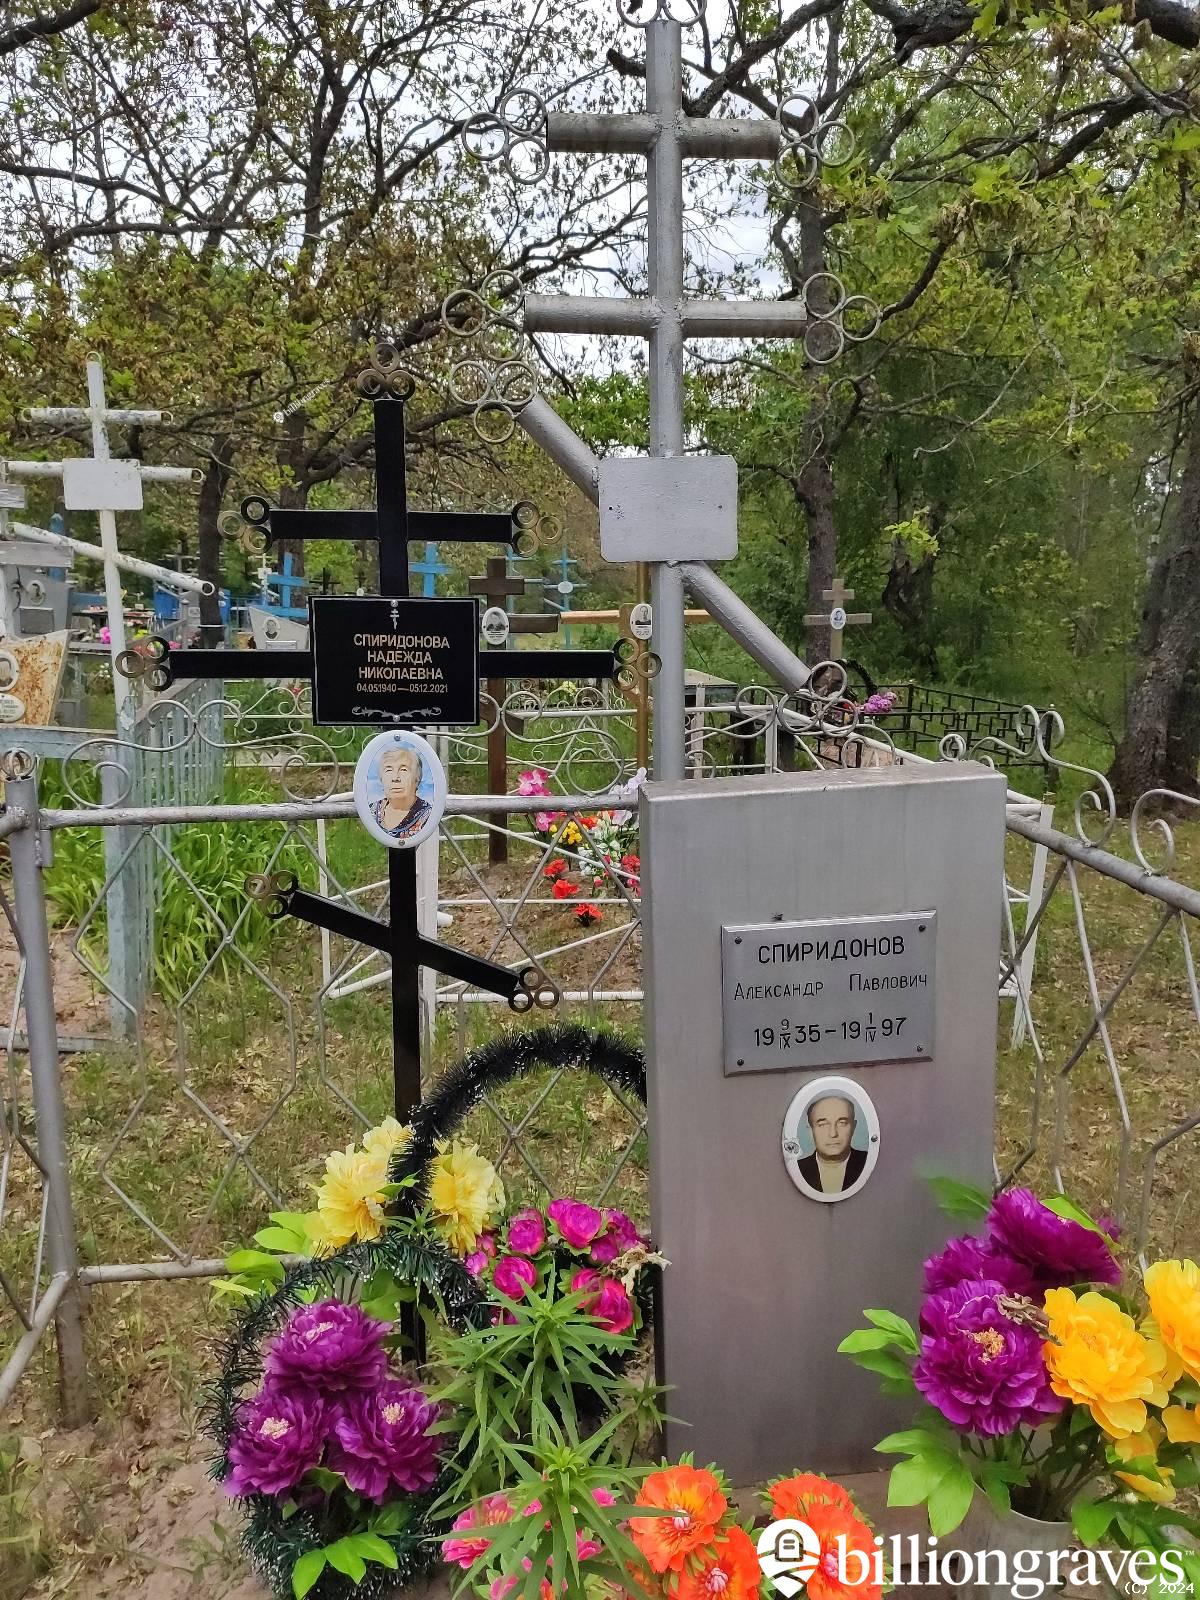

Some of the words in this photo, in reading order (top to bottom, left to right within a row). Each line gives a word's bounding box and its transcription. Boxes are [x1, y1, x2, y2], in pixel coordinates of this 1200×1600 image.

[353, 633, 450, 649] СПИРИДОНОВА
[367, 650, 433, 665] НАДЕЖДА
[358, 667, 443, 680] НИКОЛАЕВНА
[758, 936, 905, 963] СПИРИДОНОВ
